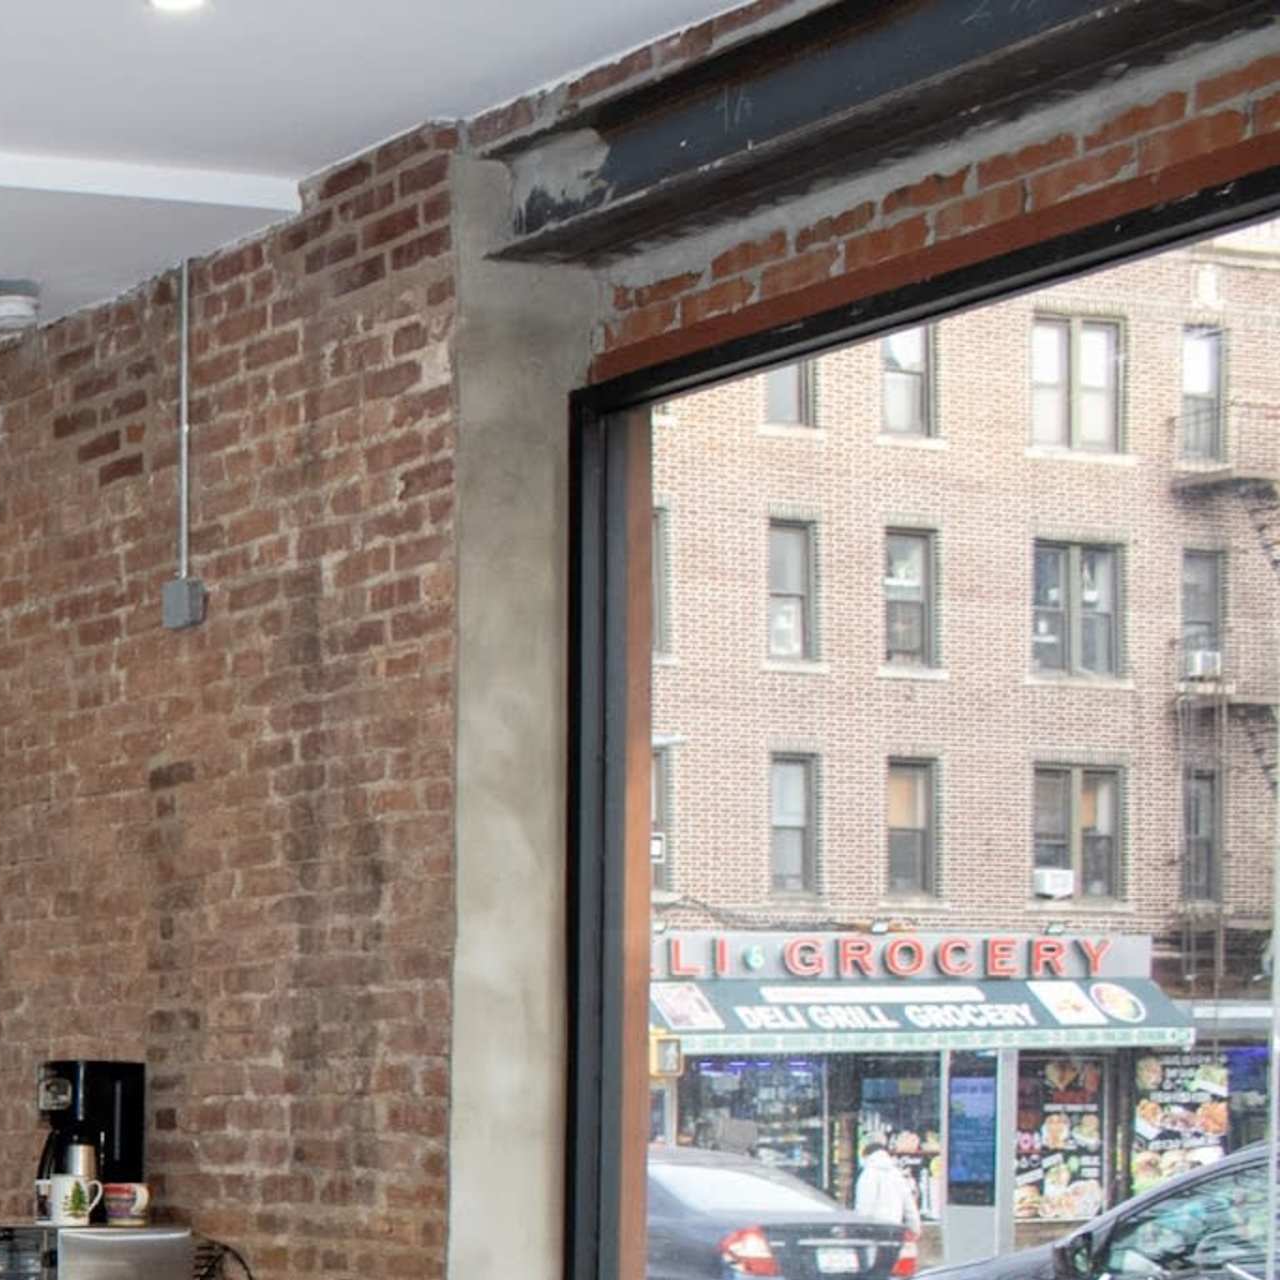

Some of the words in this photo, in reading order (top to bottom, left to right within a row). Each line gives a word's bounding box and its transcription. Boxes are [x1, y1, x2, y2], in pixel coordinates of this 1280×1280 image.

[650, 936, 730, 977] LI
[784, 933, 1111, 977] GROCERY
[733, 1004, 810, 1029] DELI
[807, 1004, 901, 1029] GRILL
[903, 1003, 1037, 1028] GROCERY
